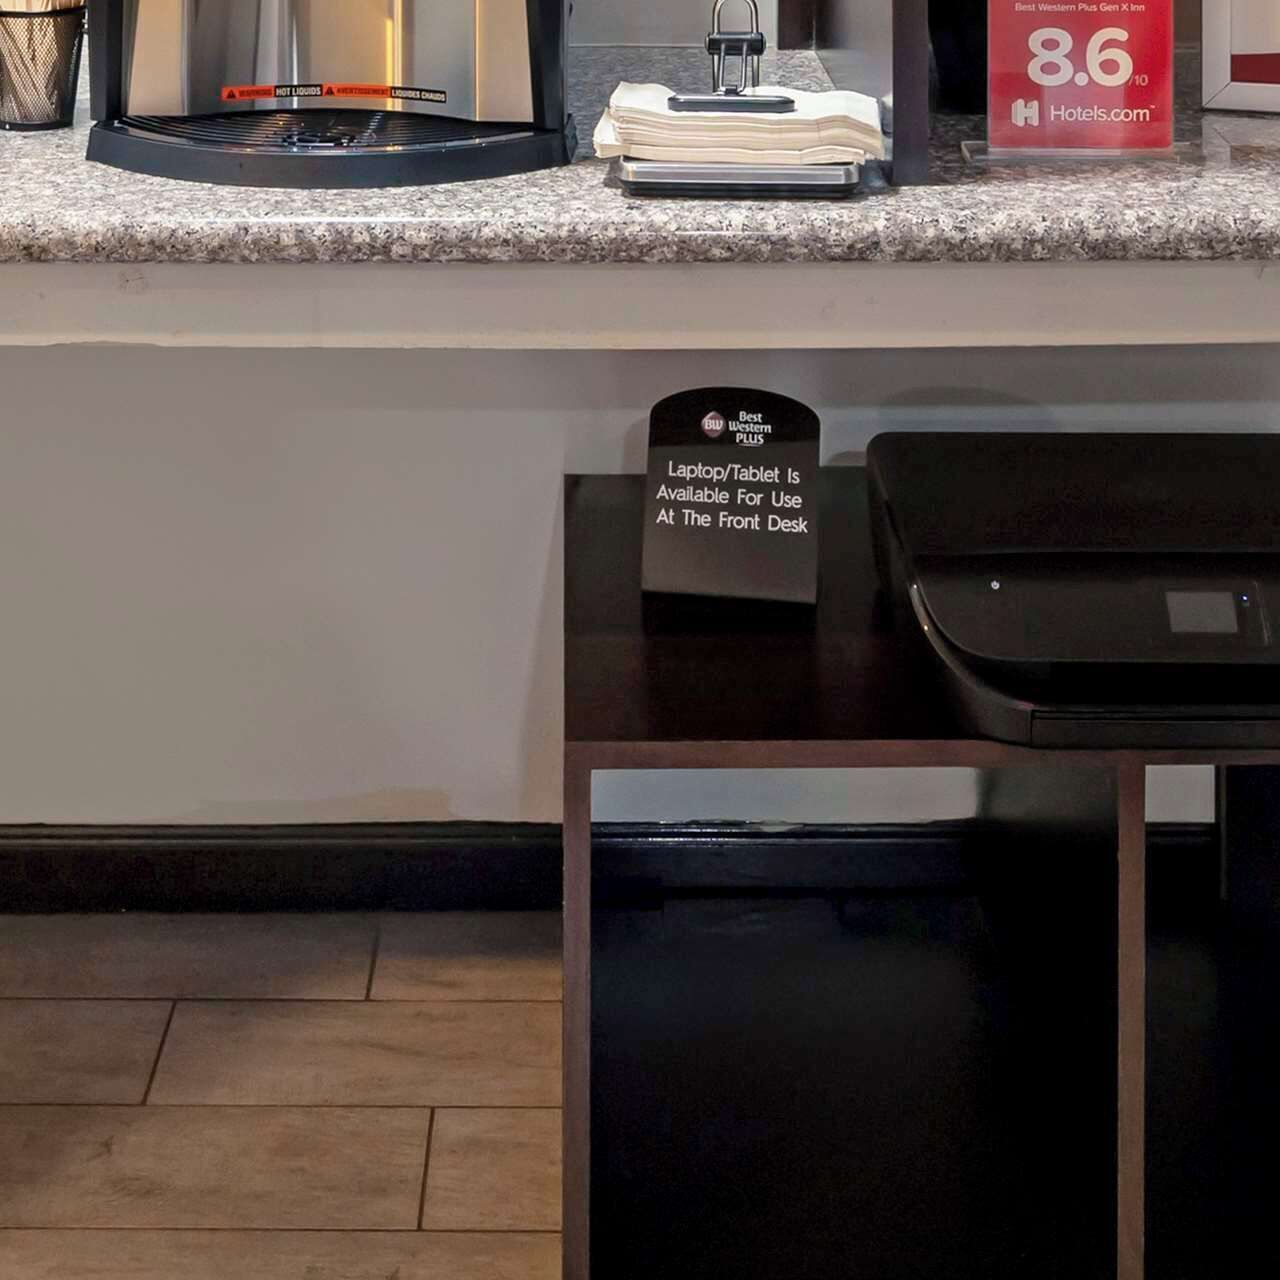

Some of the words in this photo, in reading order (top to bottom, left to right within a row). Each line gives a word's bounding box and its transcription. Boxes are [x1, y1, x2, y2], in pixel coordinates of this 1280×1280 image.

[1015, 2, 1035, 12] Best
[1038, 2, 1076, 12] Western
[1078, 2, 1097, 12] Plus
[1099, 2, 1119, 12] Gen
[1121, 2, 1129, 11] X
[1130, 2, 1145, 11] Inn
[1027, 27, 1133, 87] 8.6
[276, 87, 291, 96] HOT
[292, 86, 321, 96] LIQUIDS
[391, 88, 420, 99] LIQUIDES
[421, 91, 446, 102] CHAUDS
[1050, 104, 1150, 122] Hotels.com
[739, 411, 763, 423] Best
[704, 420, 723, 431] BW
[728, 421, 772, 433] Western
[736, 433, 764, 445] PLUS
[668, 460, 780, 483] Laptop/Tablet
[787, 468, 800, 484] Is
[656, 484, 730, 504] Available
[737, 489, 763, 506] For
[772, 491, 803, 508] Use
[656, 508, 675, 524] At
[682, 509, 712, 527] The
[719, 512, 760, 530] Front
[768, 515, 809, 533] Desk
